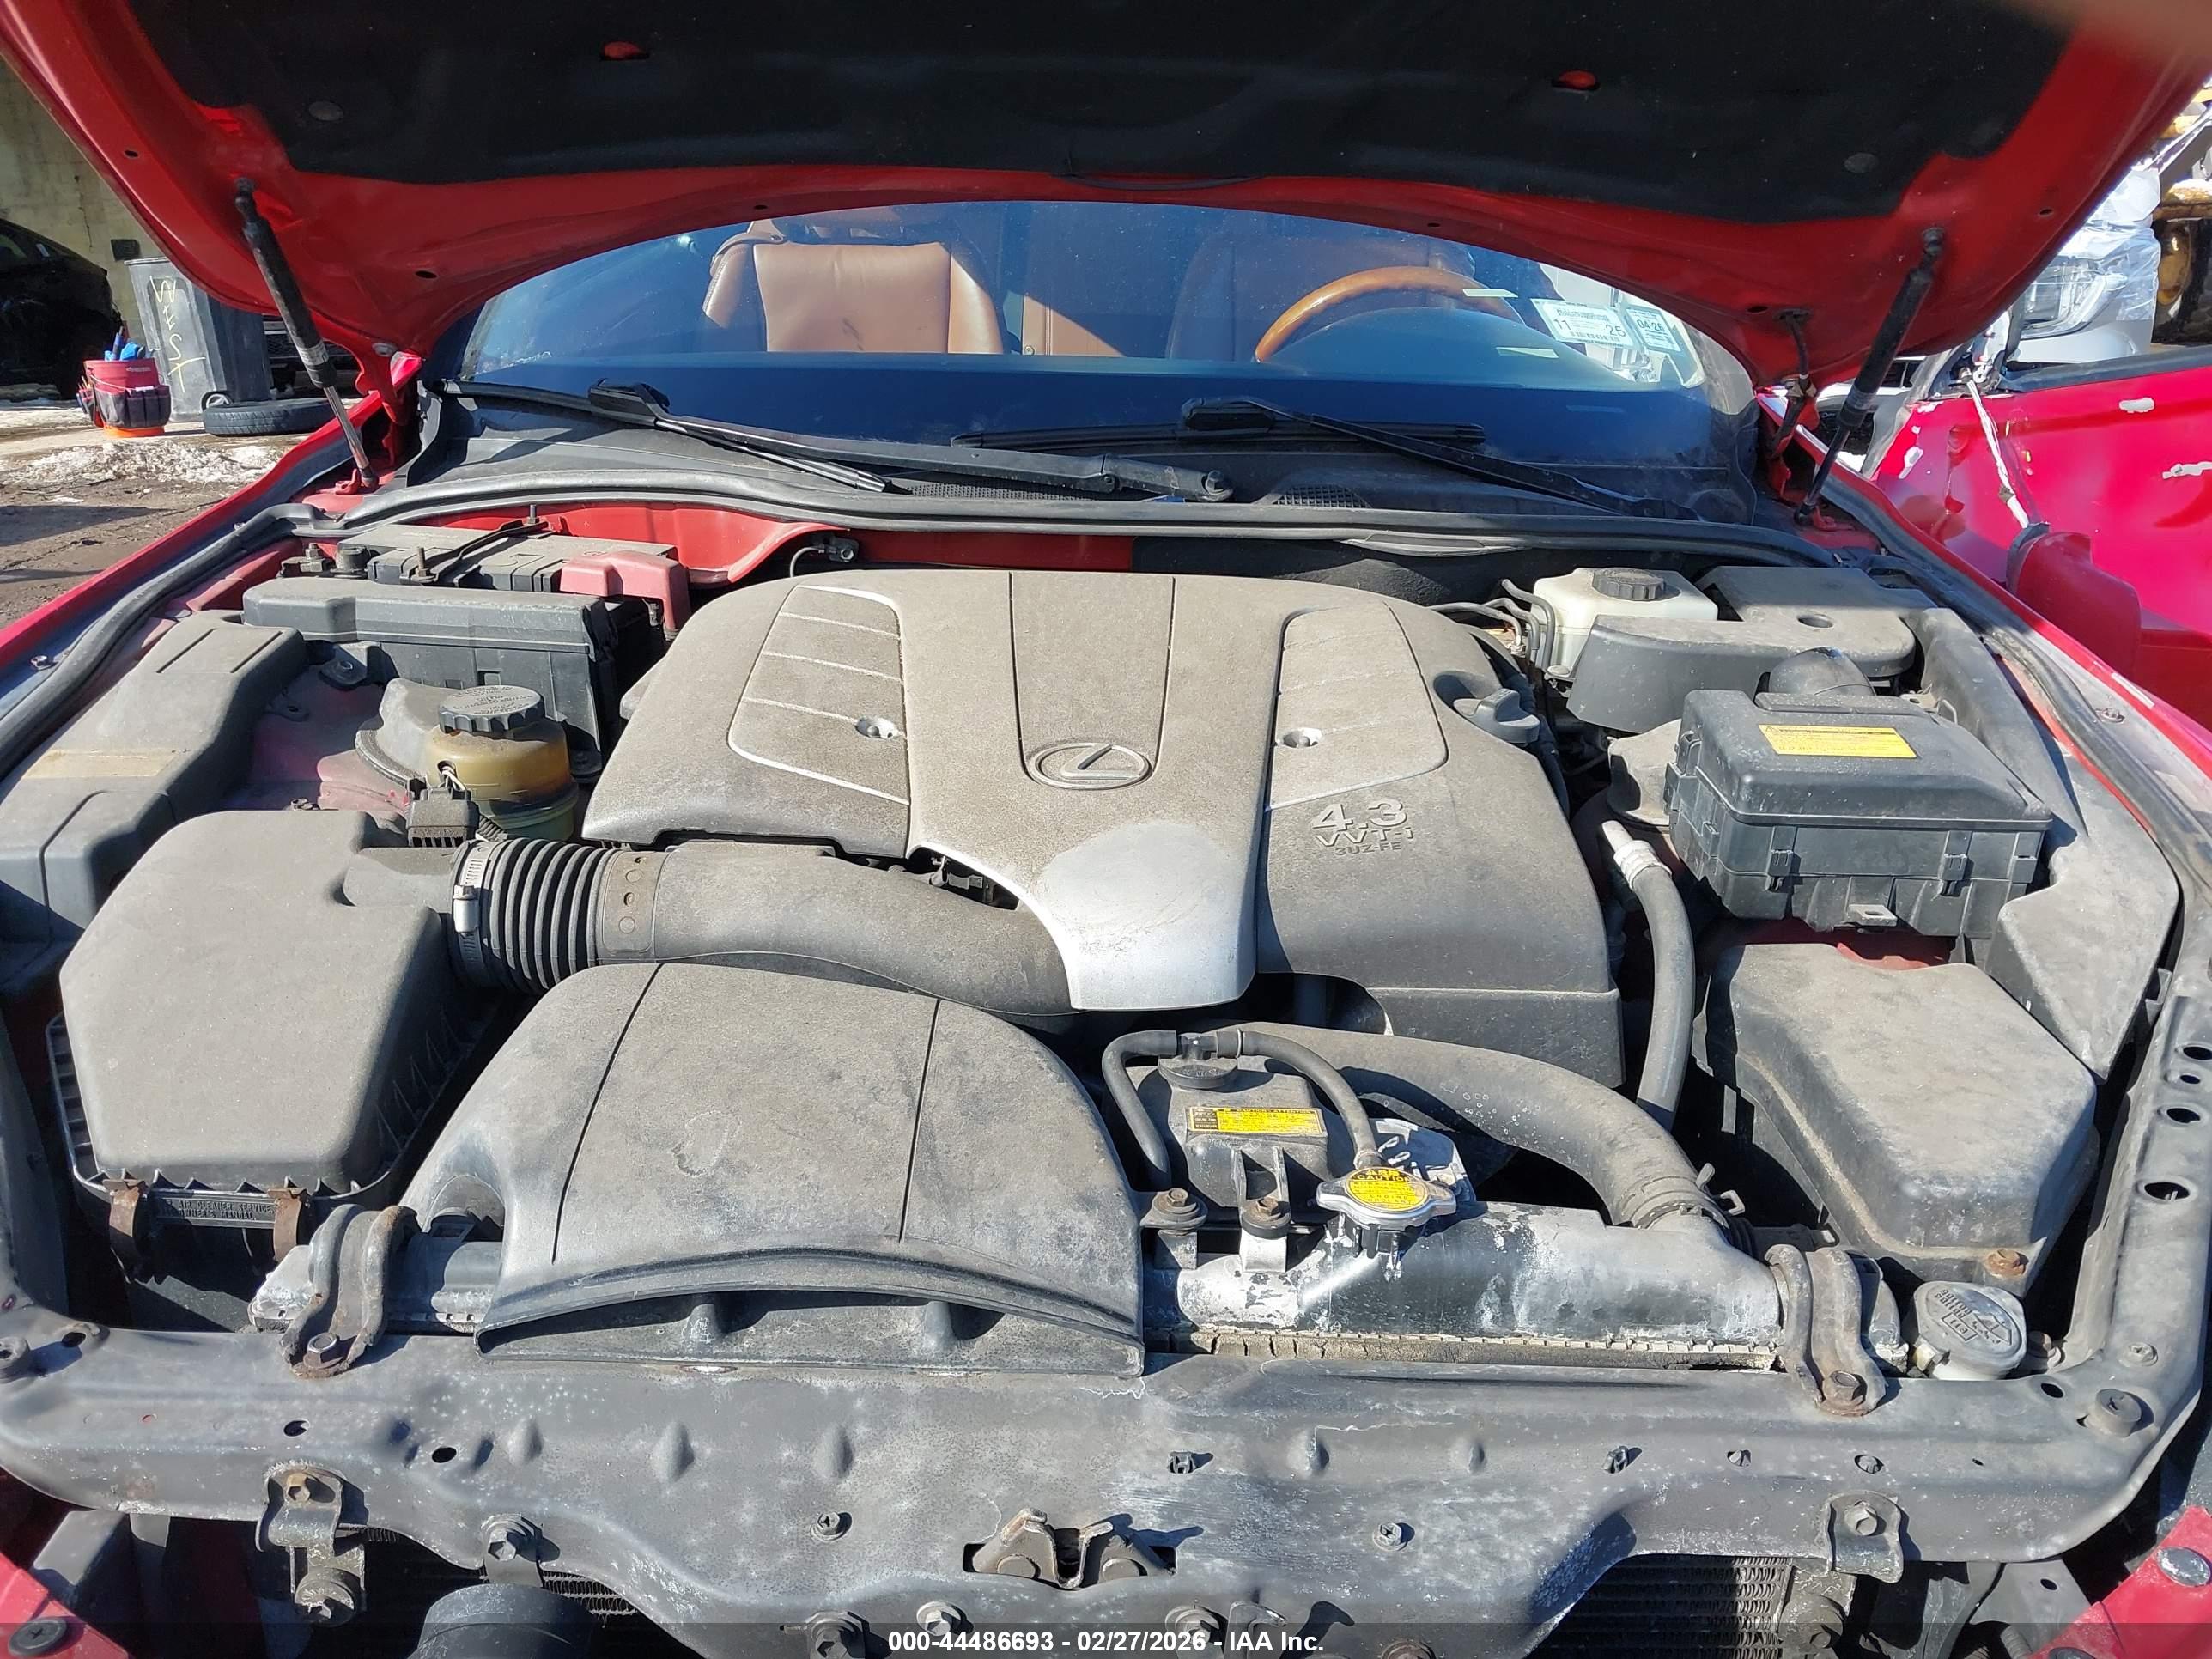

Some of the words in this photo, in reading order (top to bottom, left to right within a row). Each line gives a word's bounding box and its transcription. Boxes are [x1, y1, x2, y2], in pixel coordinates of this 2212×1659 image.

[149, 275, 206, 393] WEST
[1554, 319, 1571, 331] 11
[1605, 324, 1626, 337] 25
[1312, 799, 1408, 832] 4.3
[1334, 842, 1402, 856] 3UZ-FE
[179, 1208, 216, 1218] OWNER'S
[198, 1200, 234, 1211] CLEANER
